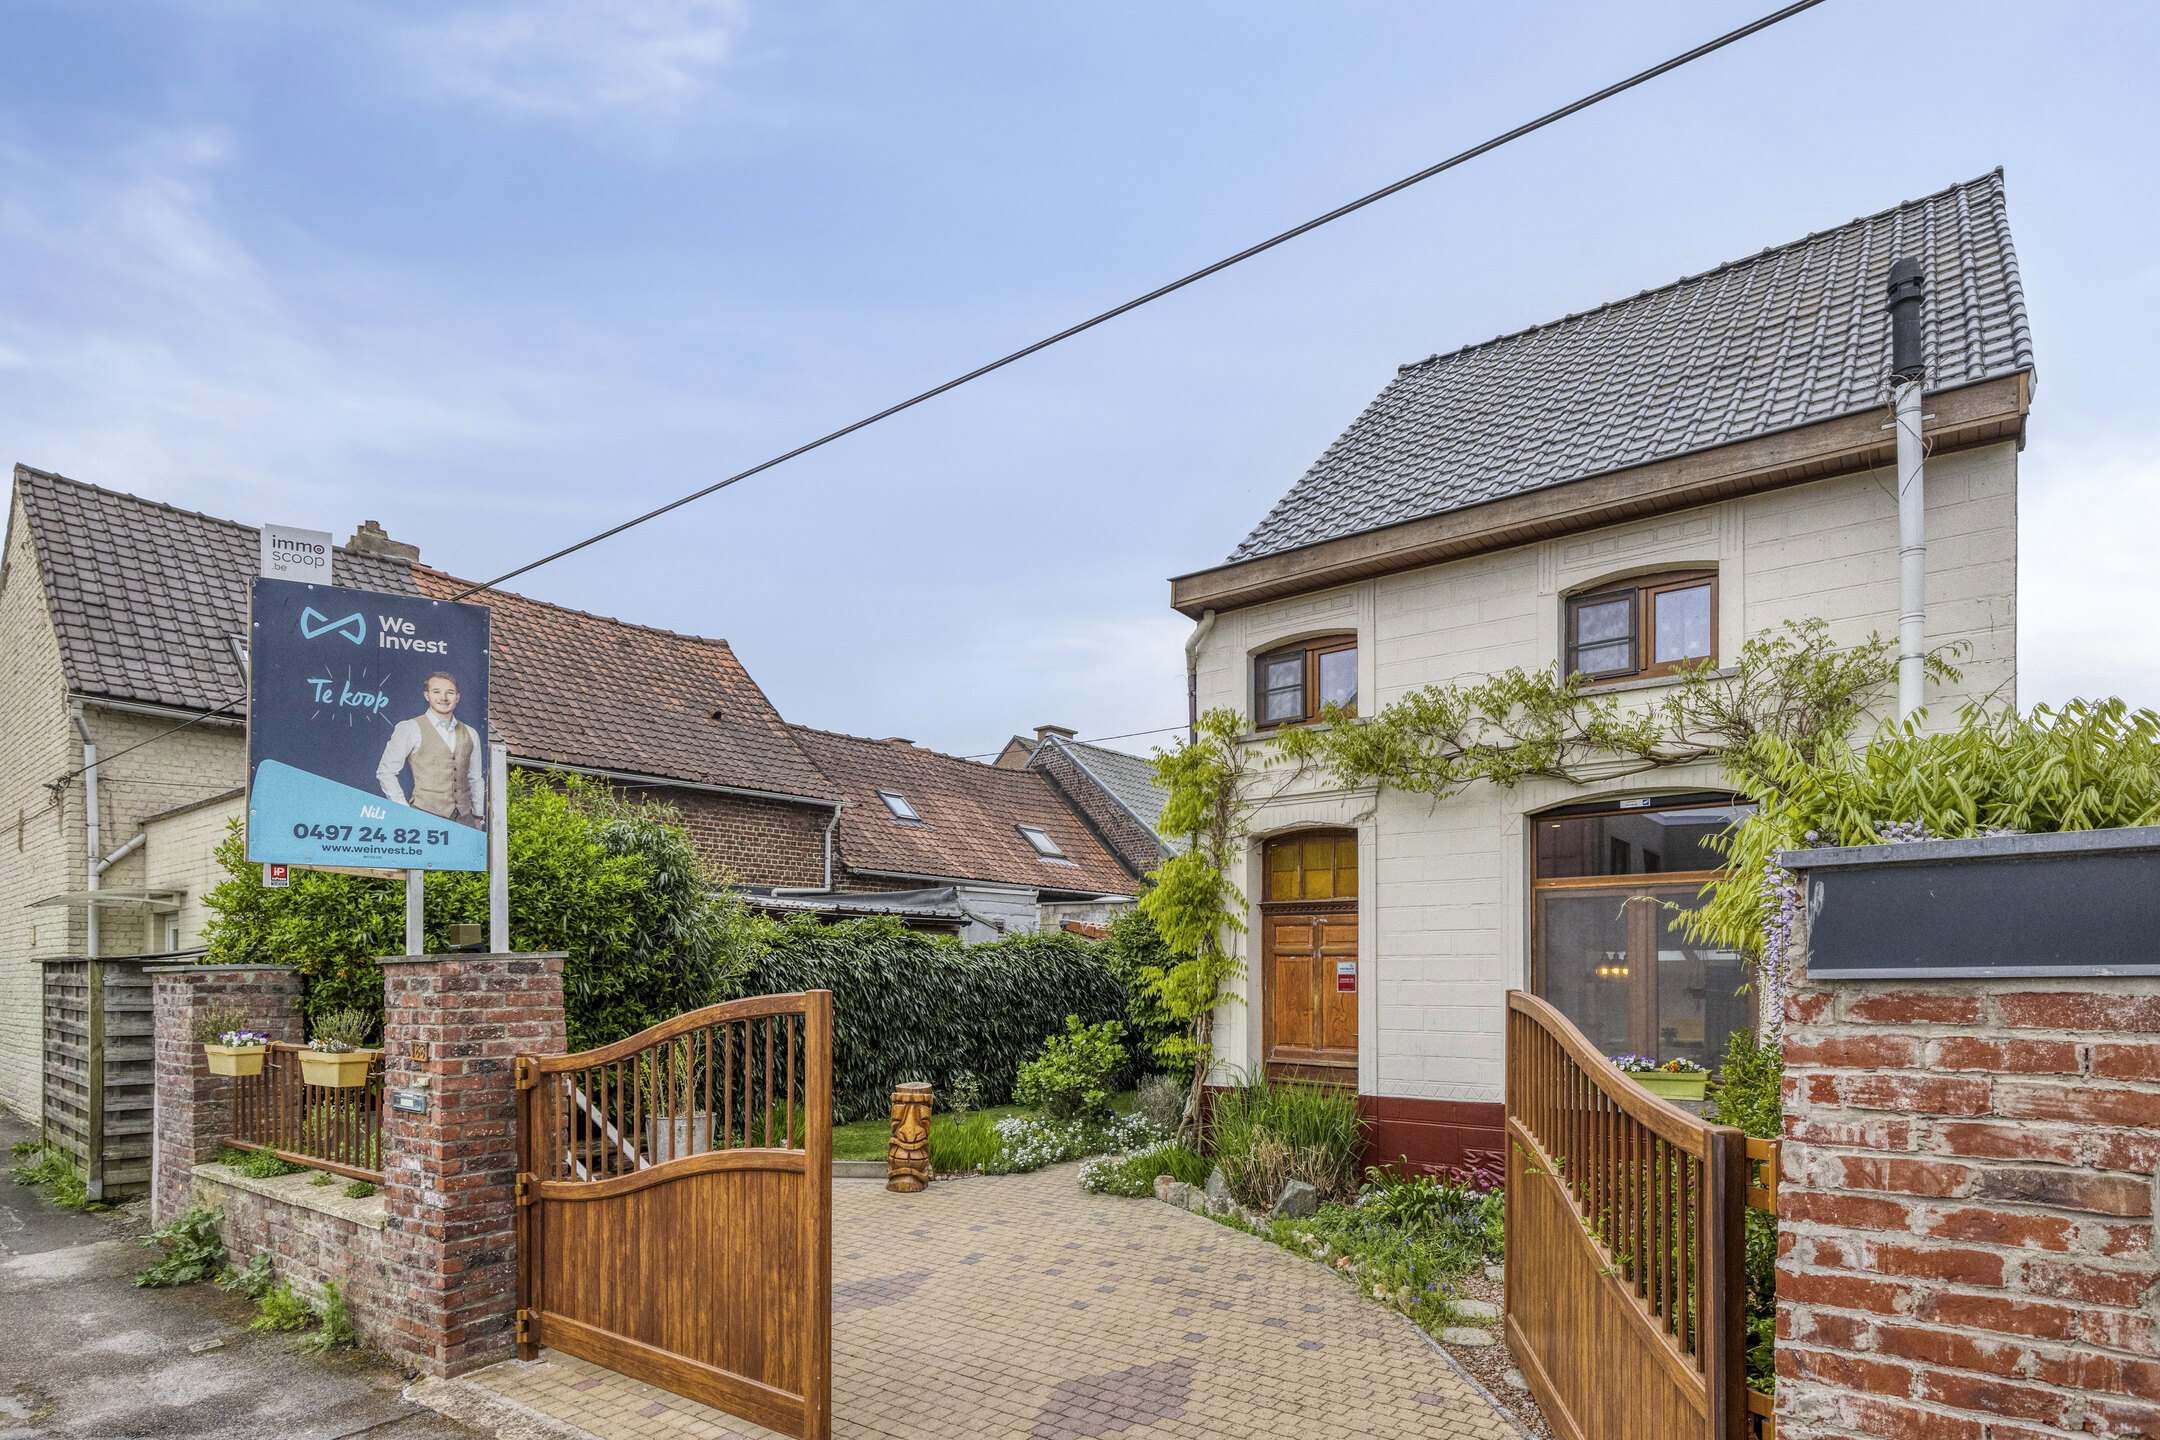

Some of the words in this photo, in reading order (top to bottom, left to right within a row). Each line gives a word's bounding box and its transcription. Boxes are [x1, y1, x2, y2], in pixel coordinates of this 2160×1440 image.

[272, 535, 325, 555] immo
[272, 550, 325, 568] scoop
[272, 562, 287, 572] .be
[379, 616, 415, 635] We
[379, 632, 447, 654] Invest
[307, 679, 333, 703] Te
[339, 680, 389, 714] koop
[360, 805, 386, 819] Nils
[293, 823, 352, 842] 0497
[358, 826, 387, 843] 24
[393, 829, 421, 844] 82
[426, 830, 449, 845] 51
[321, 844, 423, 856] www.weinvest.be
